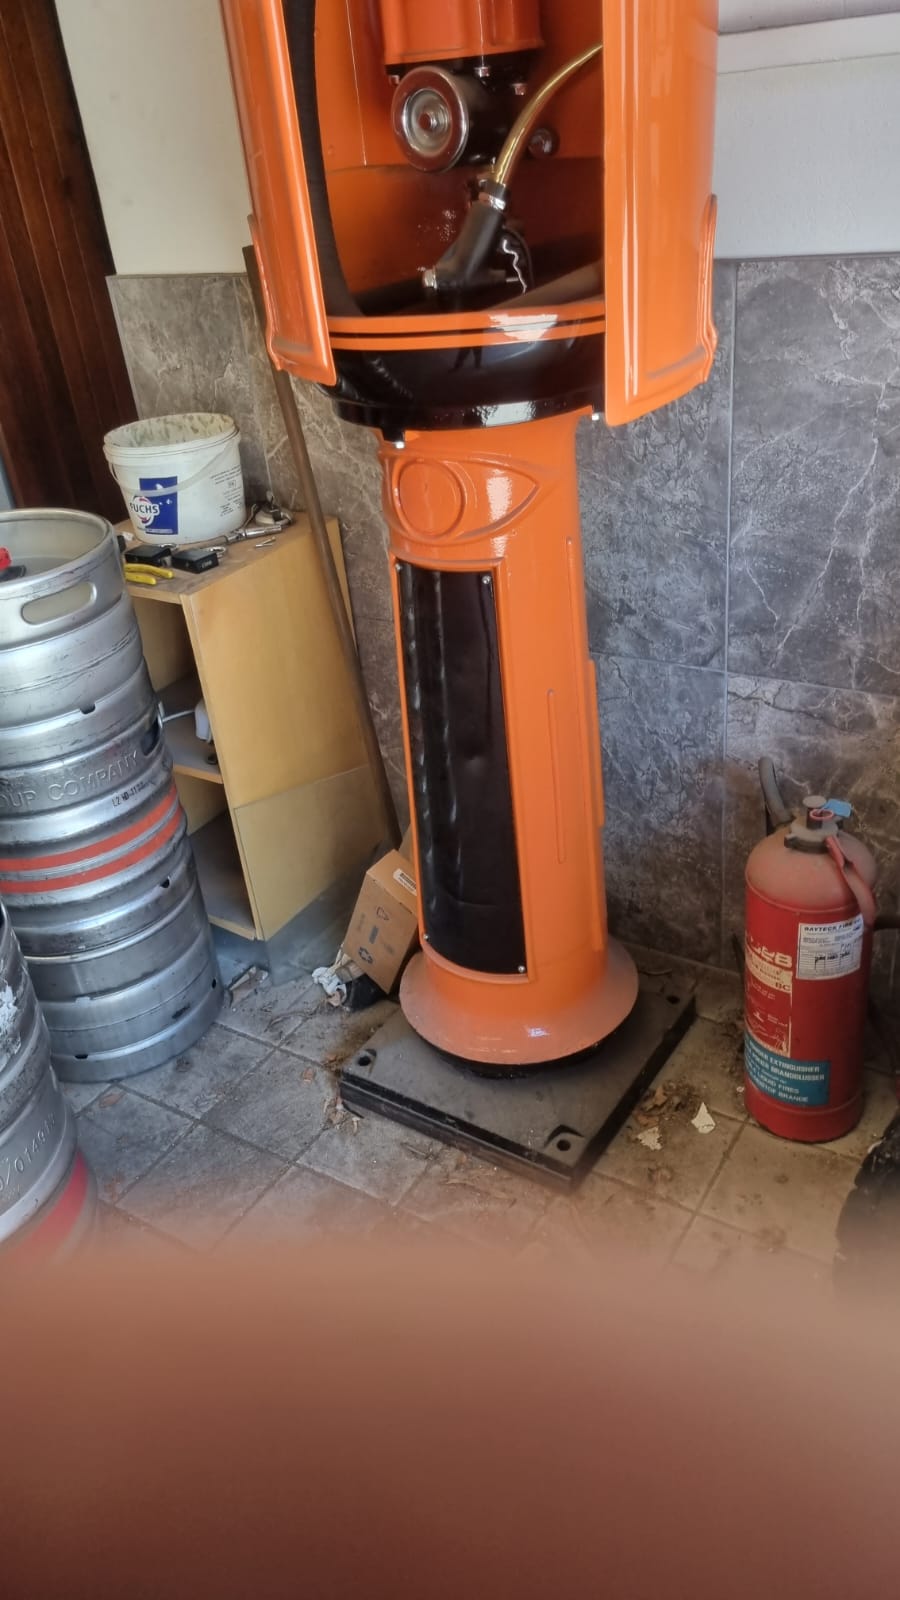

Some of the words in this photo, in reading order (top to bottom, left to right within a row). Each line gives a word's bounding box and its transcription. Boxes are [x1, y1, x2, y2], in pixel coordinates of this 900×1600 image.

[130, 502, 159, 514] FUCHS
[48, 750, 137, 801] COMPANY
[770, 1057, 820, 1073] EXTINGUISHER
